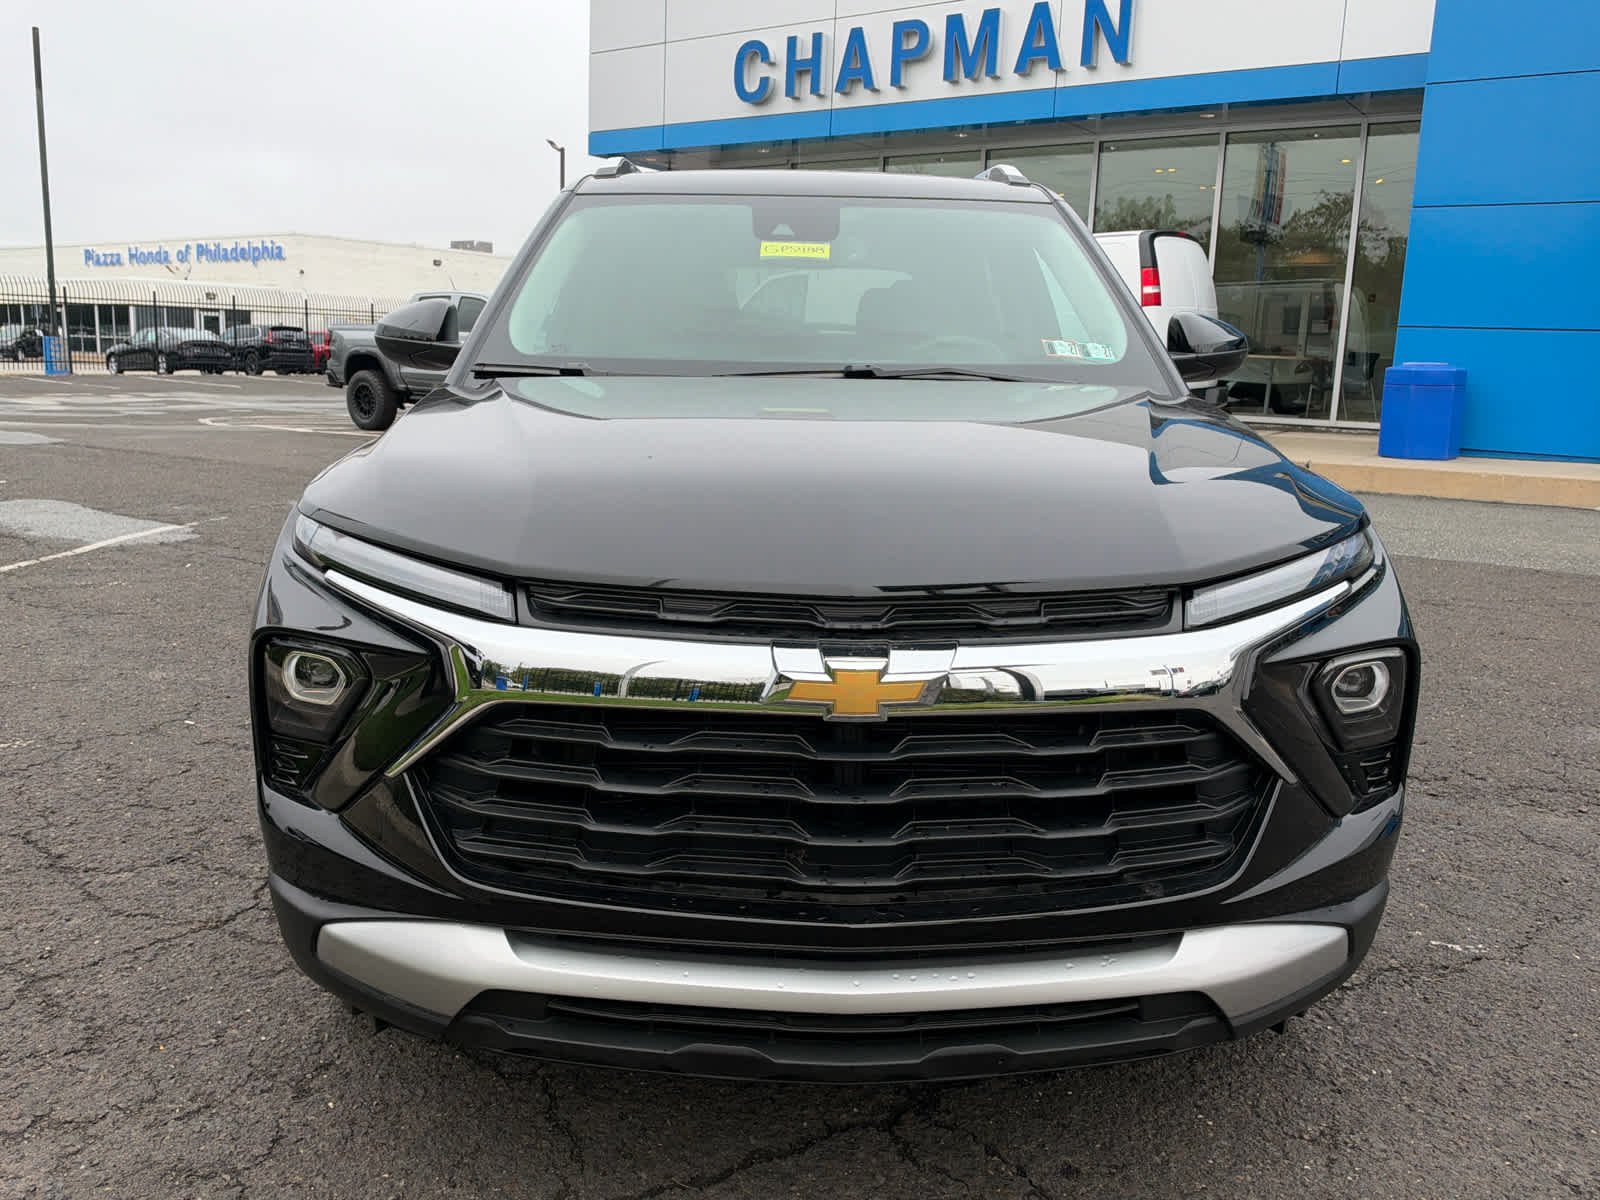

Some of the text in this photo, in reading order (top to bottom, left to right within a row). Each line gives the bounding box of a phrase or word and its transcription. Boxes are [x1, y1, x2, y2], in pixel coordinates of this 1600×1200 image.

[734, 0, 1135, 105] CHAPMAN
[84, 240, 286, 267] Piazza Honda of Philadelphia
